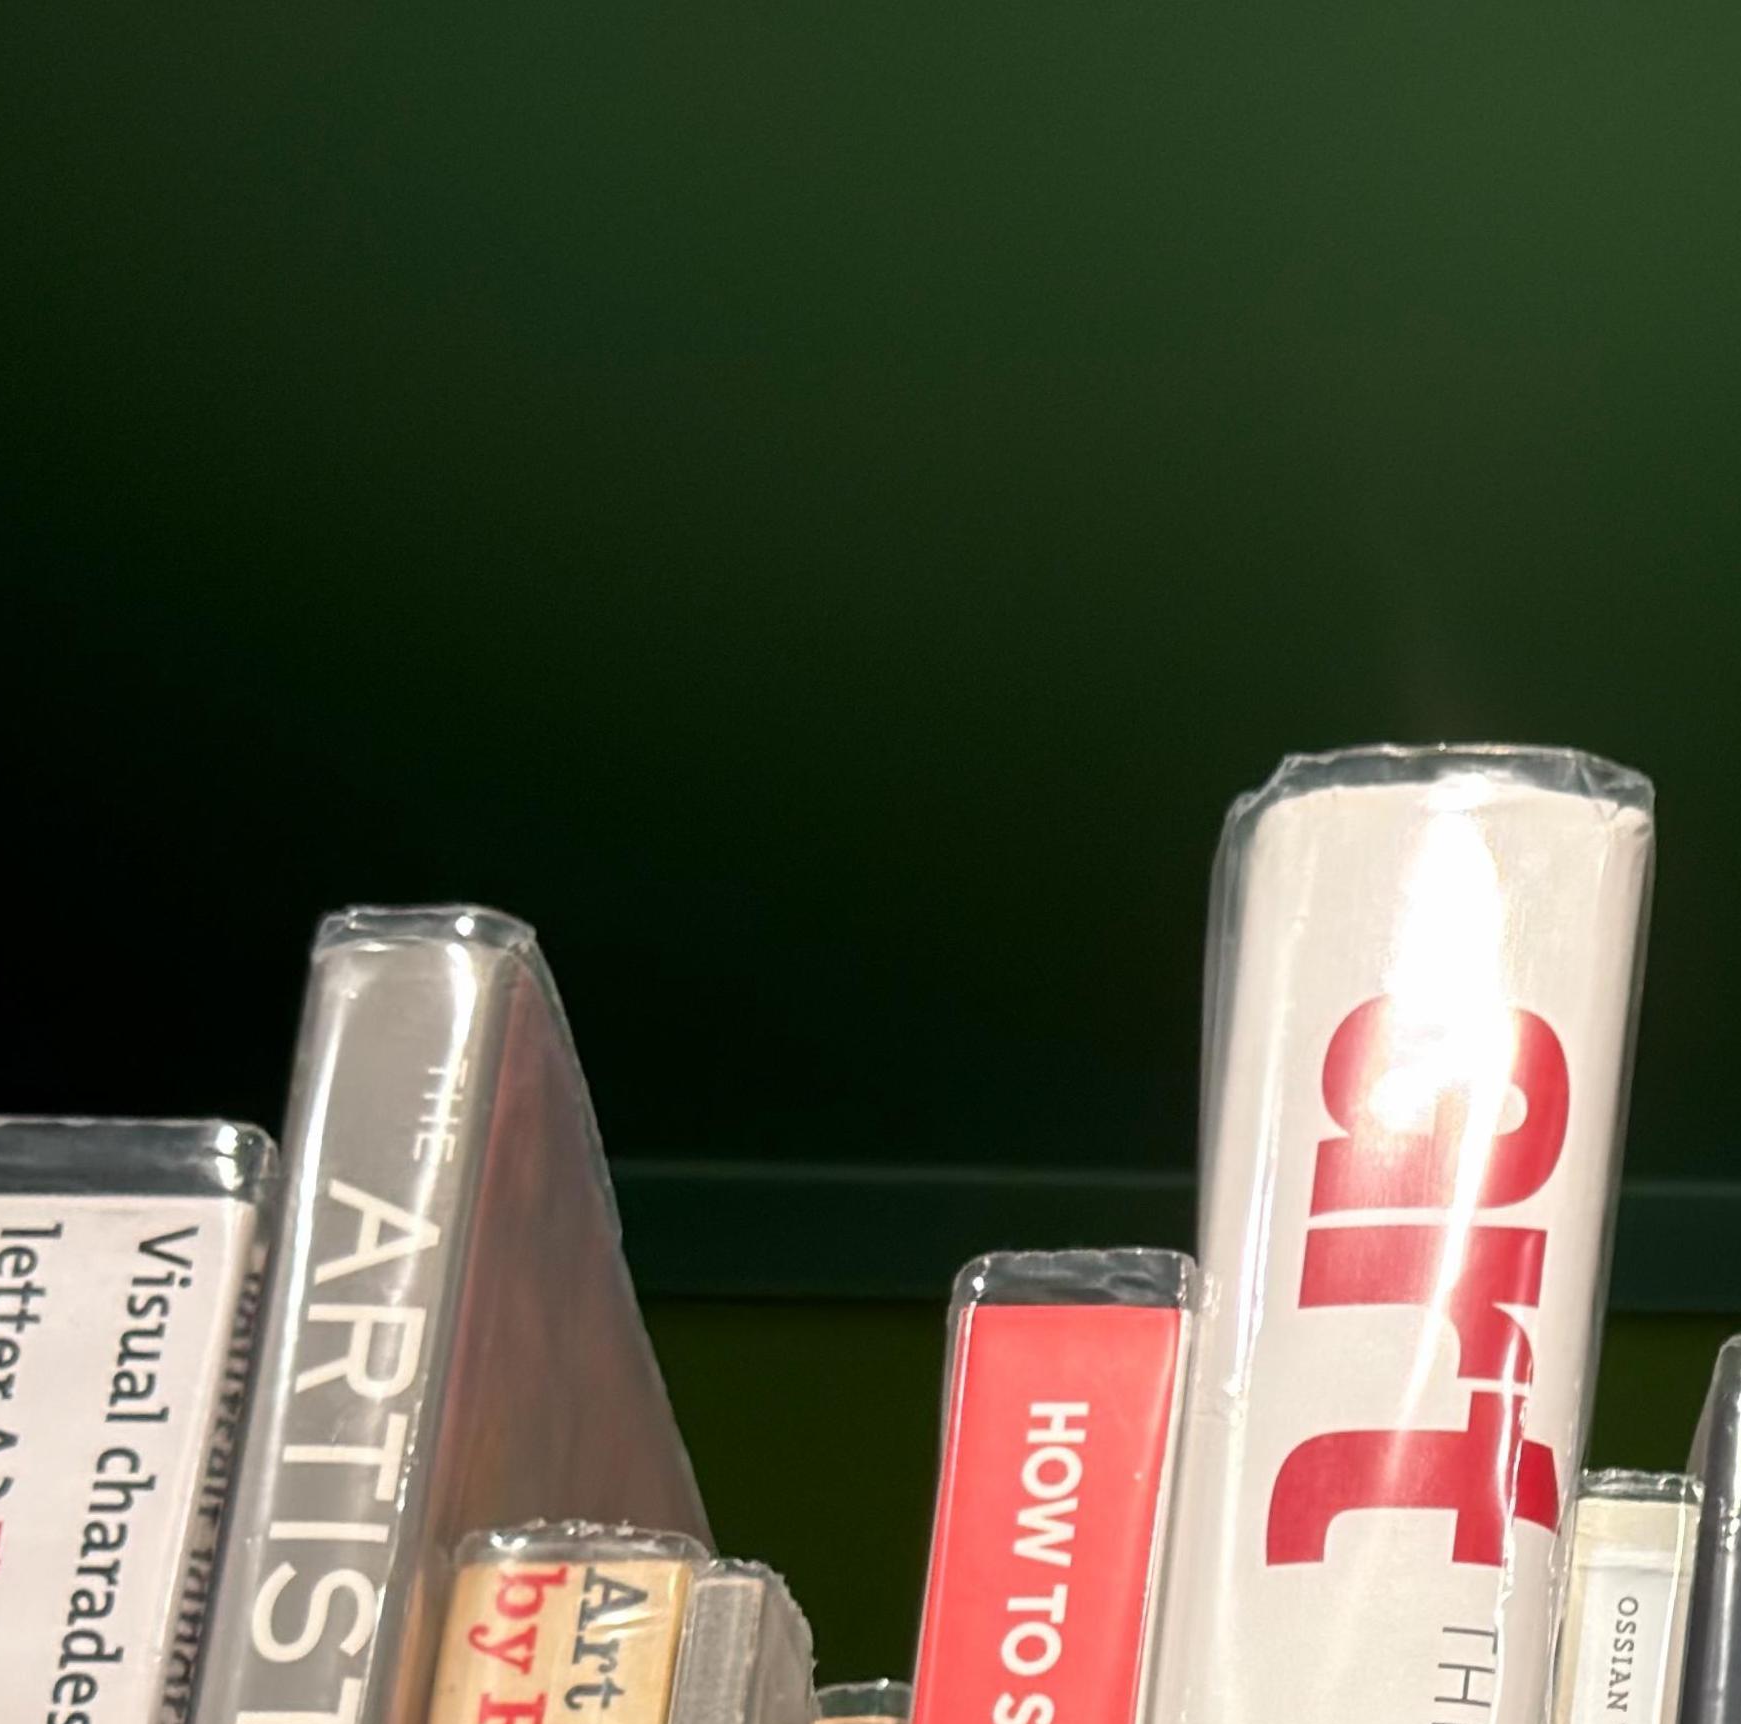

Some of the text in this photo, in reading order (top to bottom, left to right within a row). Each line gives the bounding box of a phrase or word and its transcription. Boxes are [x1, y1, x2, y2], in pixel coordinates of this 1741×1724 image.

[412, 1062, 469, 1162] THE
[1265, 995, 1569, 1566] art
[1013, 1402, 1090, 1566] HOW
[465, 1564, 567, 1675] by
[565, 1566, 649, 1709] Art
[1001, 1584, 1068, 1677] TO
[1607, 1596, 1641, 1713] OSSIAN
